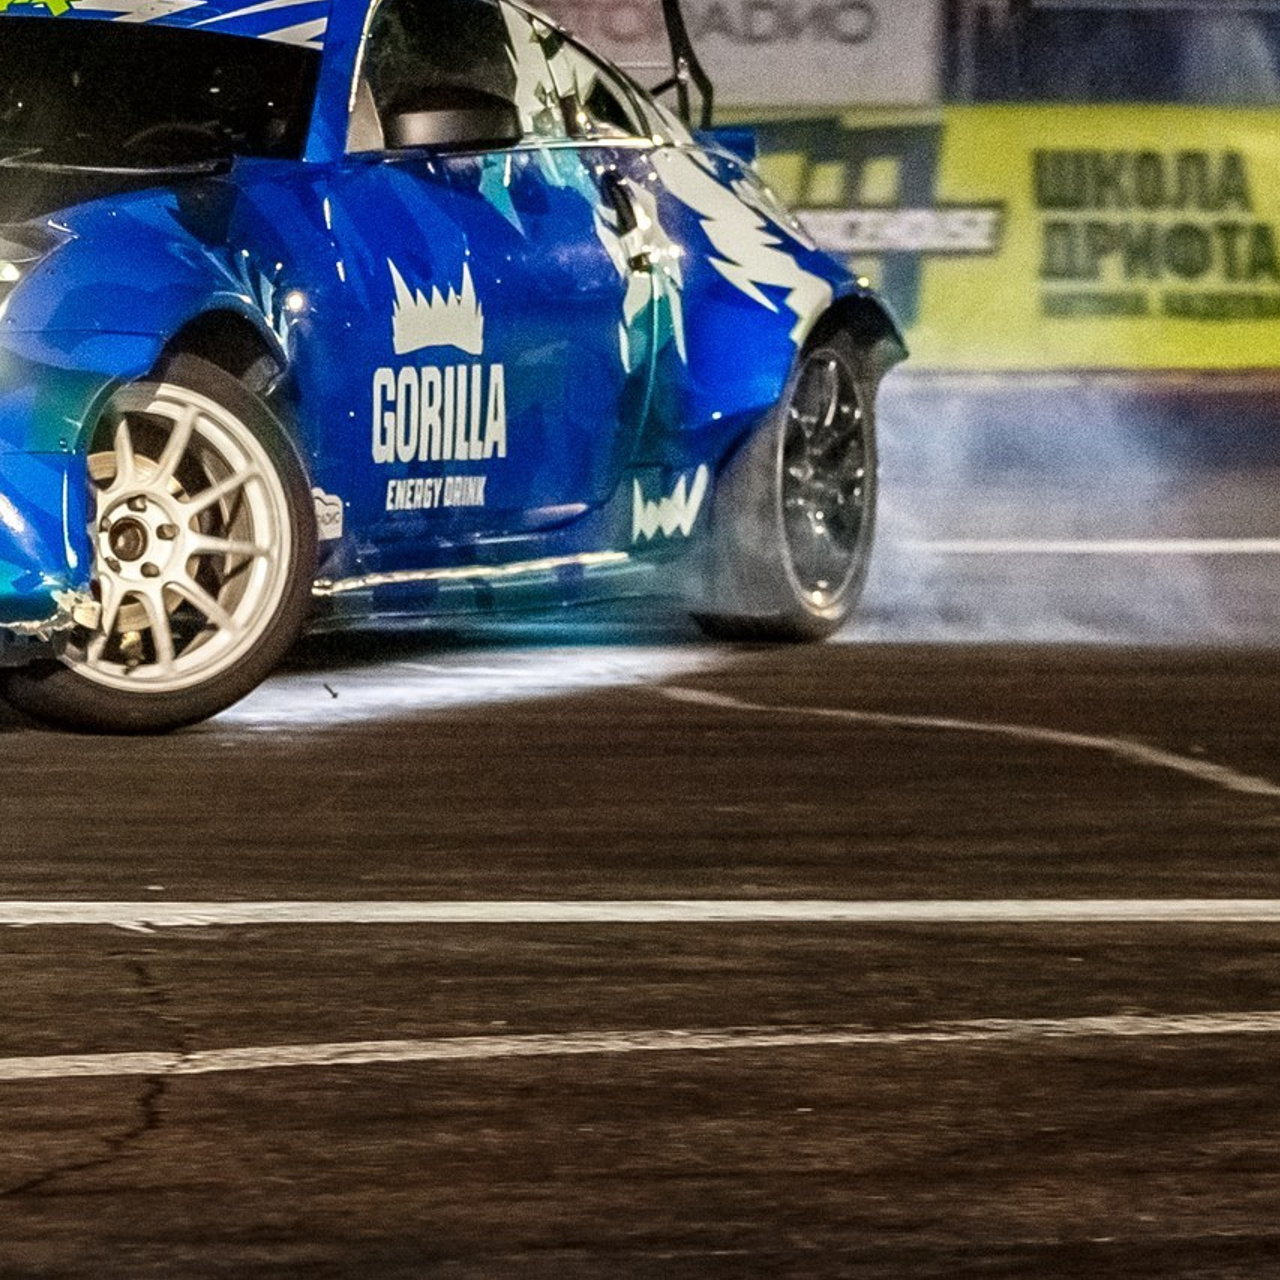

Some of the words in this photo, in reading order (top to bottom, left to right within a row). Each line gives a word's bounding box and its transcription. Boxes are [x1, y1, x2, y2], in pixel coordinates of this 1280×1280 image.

[1033, 146, 1255, 212] ШКОЛА
[1039, 220, 1280, 282] ДРИФТА
[371, 363, 507, 465] GORILLA
[385, 478, 444, 511] ENERGY
[443, 475, 487, 507] DRINK
